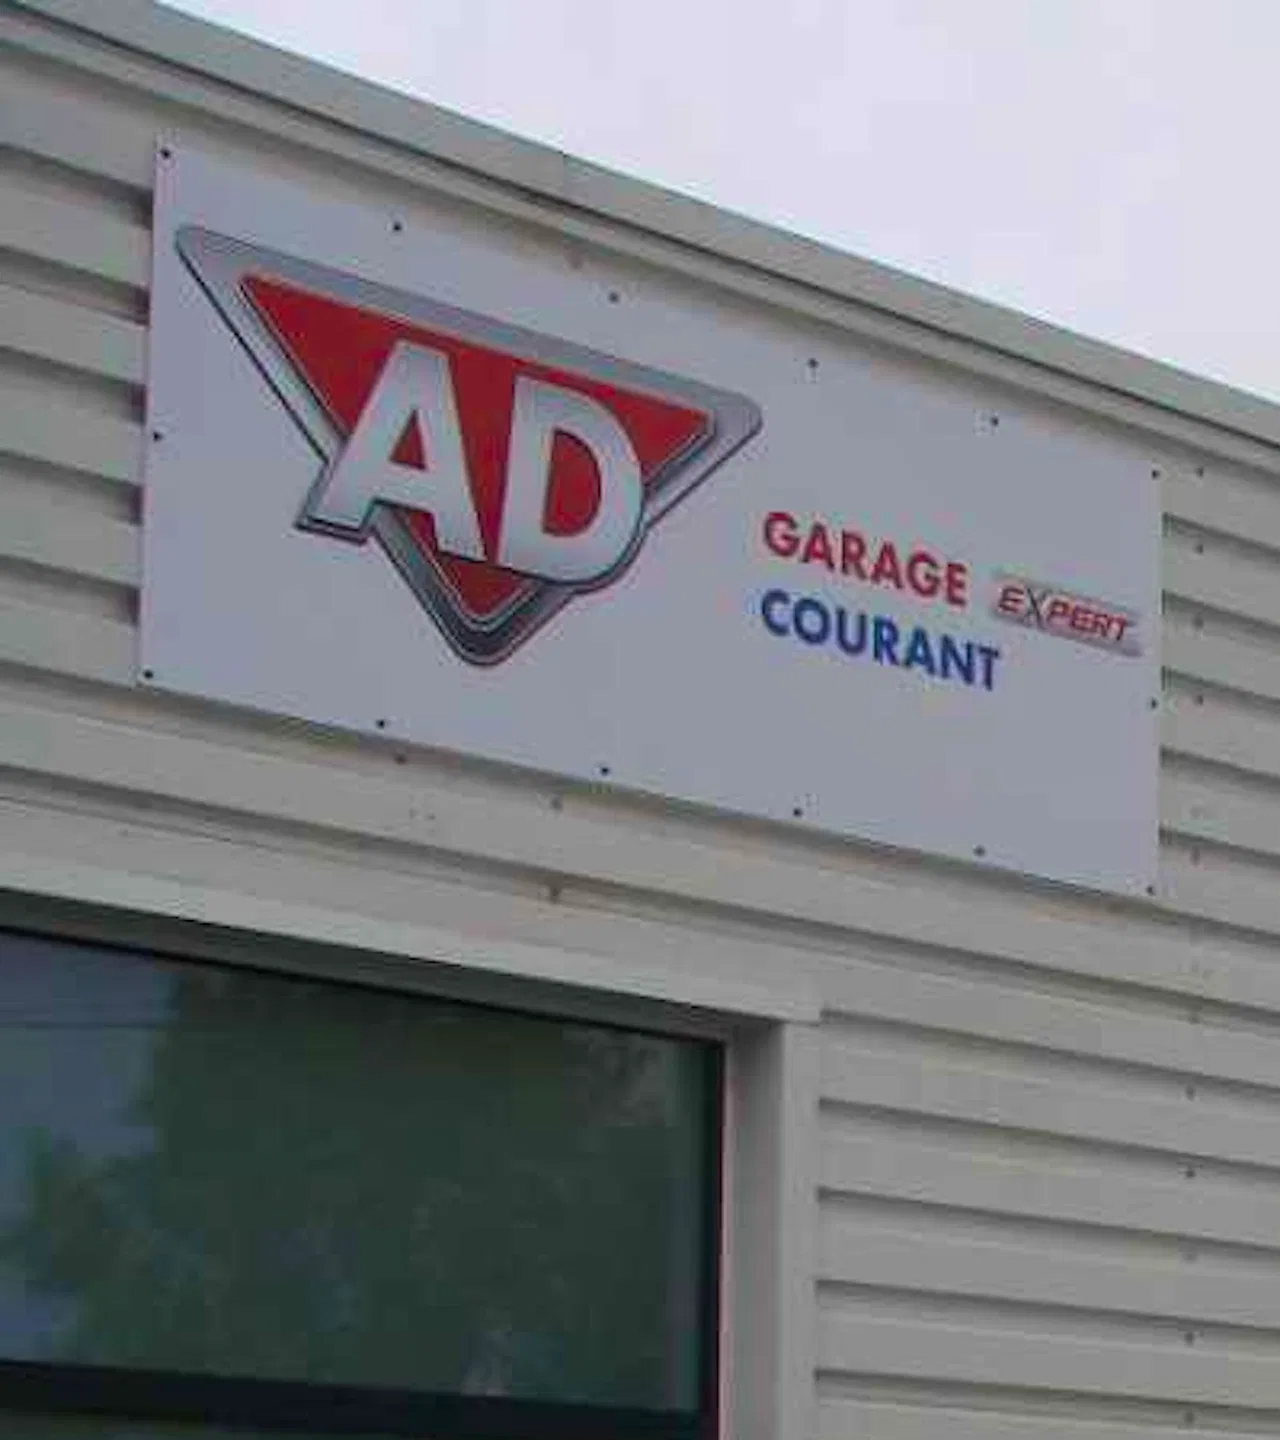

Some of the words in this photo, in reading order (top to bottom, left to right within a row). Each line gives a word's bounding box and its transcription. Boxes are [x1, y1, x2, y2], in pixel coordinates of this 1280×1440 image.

[300, 336, 645, 583] AD
[764, 511, 968, 607] GARAGE
[760, 589, 1000, 690] COURANT
[998, 585, 1127, 642] EXPERT
